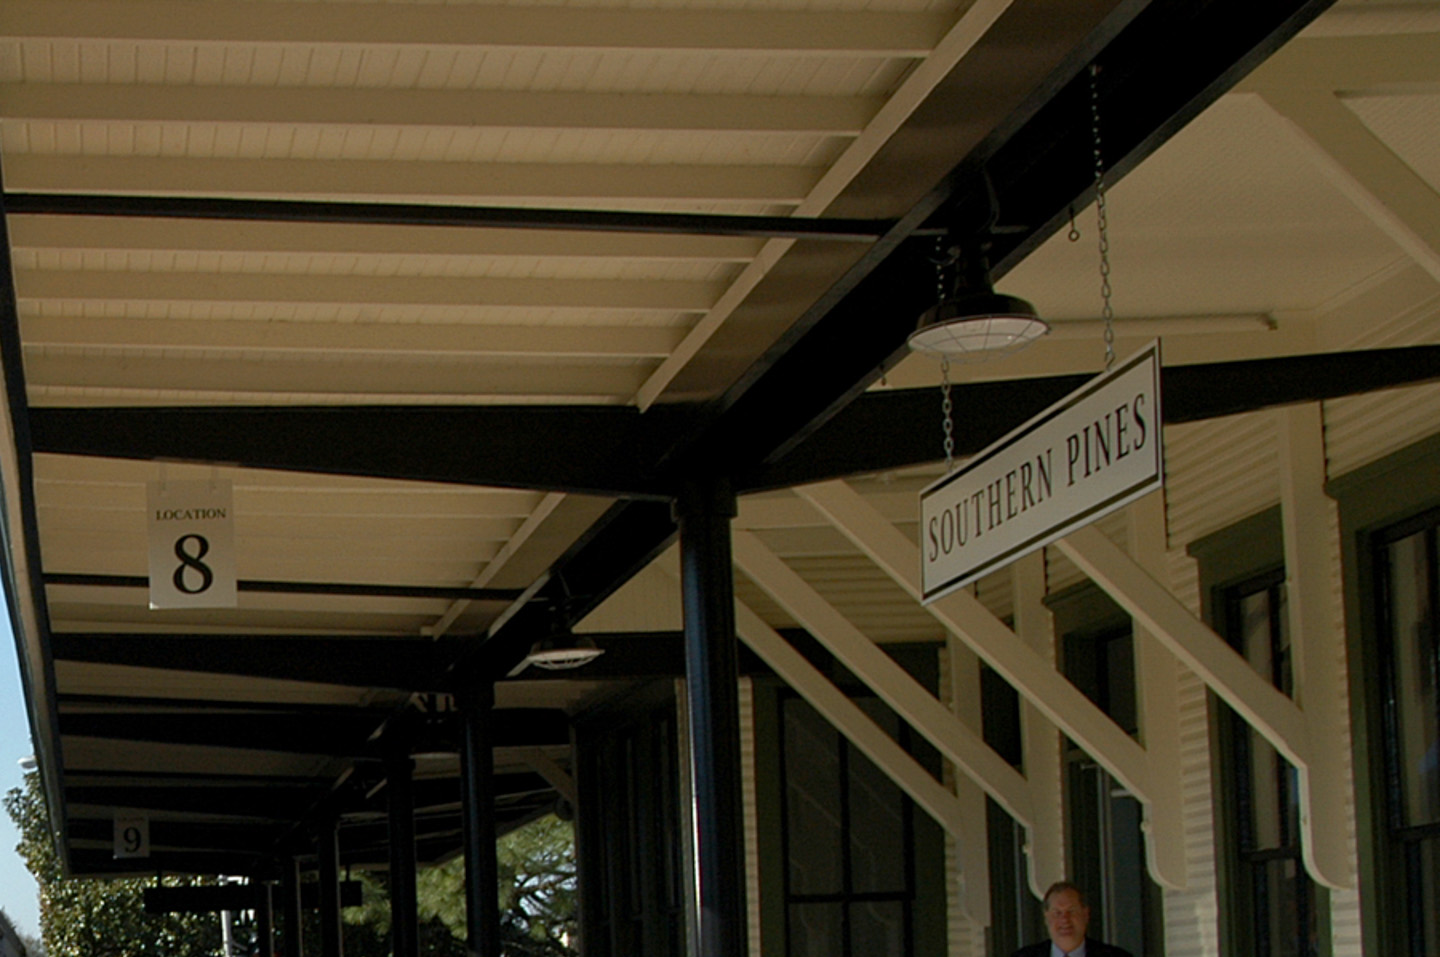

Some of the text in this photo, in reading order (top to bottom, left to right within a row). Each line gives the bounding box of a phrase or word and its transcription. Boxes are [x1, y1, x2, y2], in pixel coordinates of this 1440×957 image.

[928, 392, 1148, 563] SOUTHERN PINES
[155, 507, 227, 521] LOCATION
[172, 533, 214, 594] 8
[123, 827, 141, 853] 9
